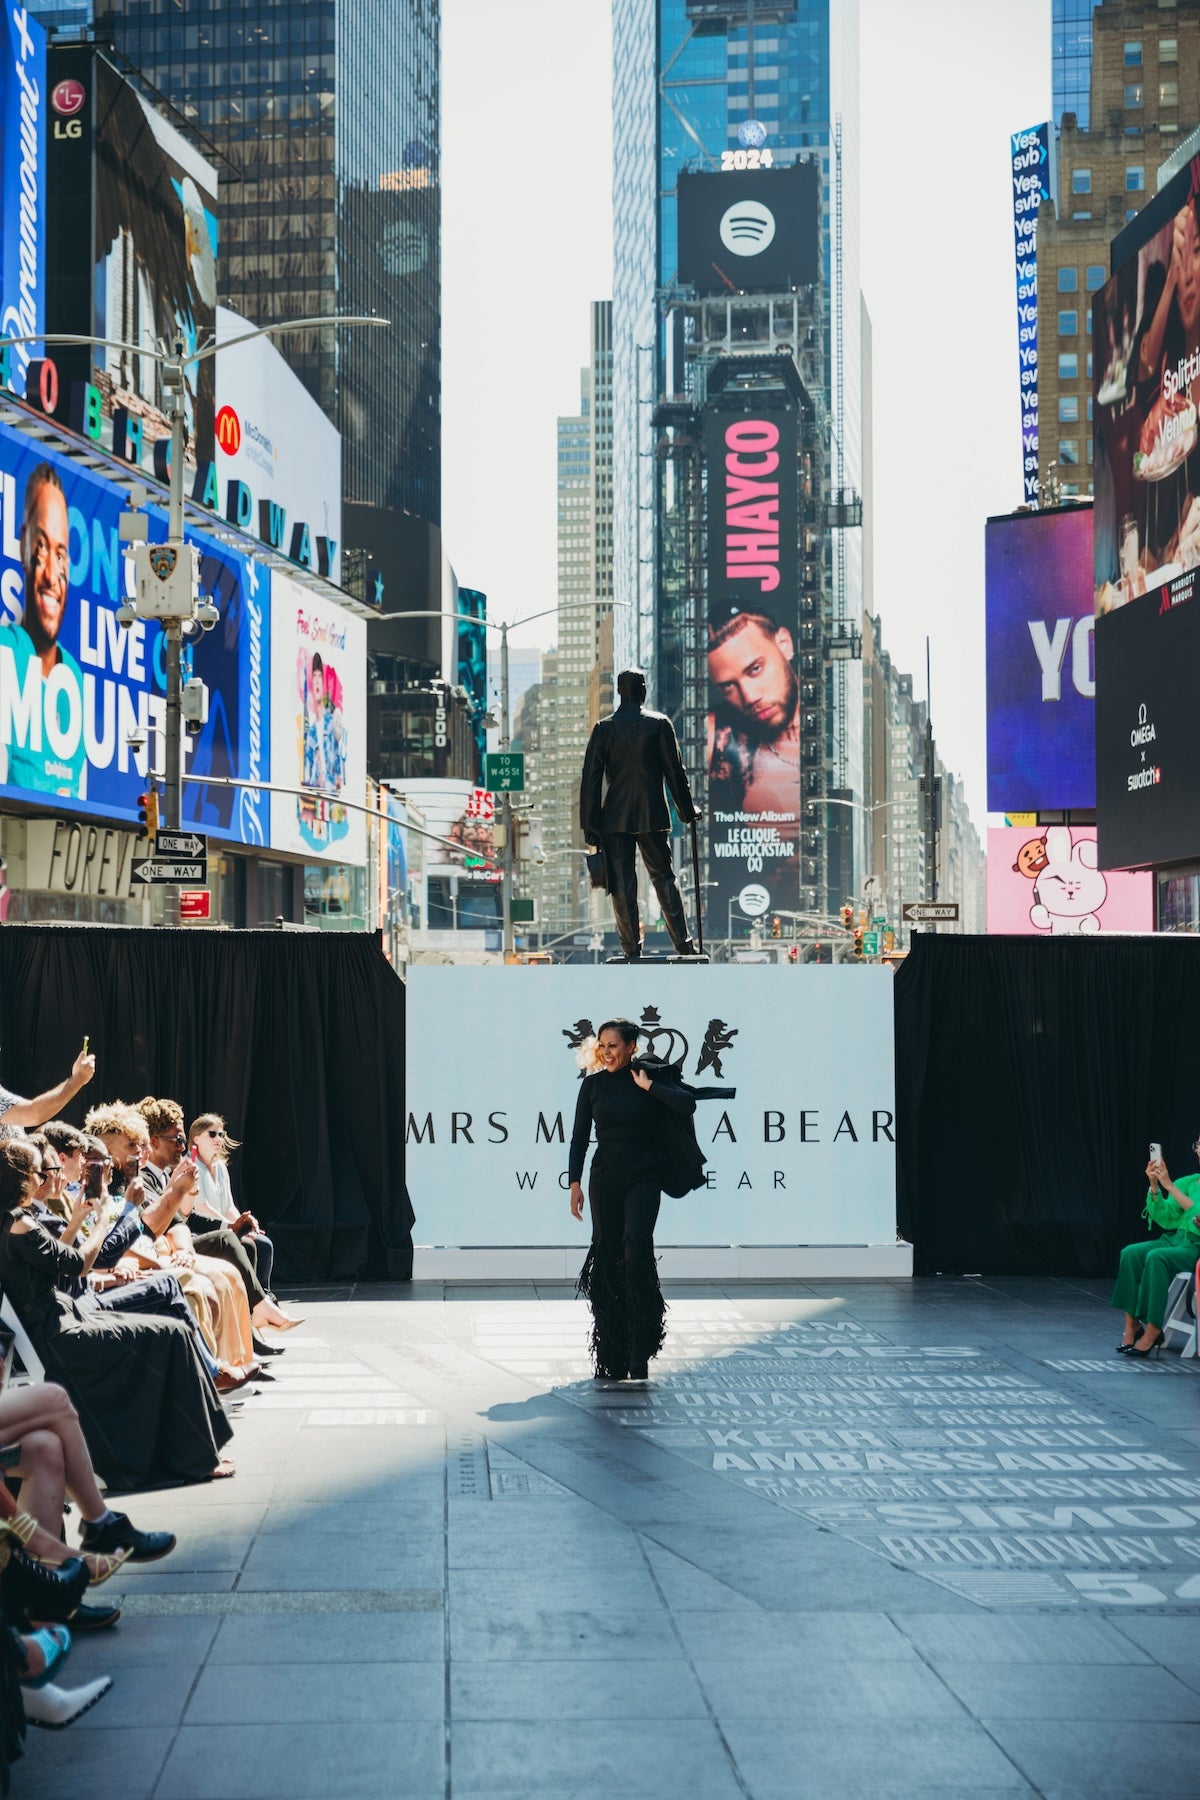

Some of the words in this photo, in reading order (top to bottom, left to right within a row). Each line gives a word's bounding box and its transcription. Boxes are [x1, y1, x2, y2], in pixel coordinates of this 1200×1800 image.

[54, 119, 82, 139] LG
[1012, 131, 1040, 151] Yes,
[721, 148, 773, 171] 2024
[1013, 147, 1040, 171] svb
[1013, 174, 1042, 195] Yes,
[1015, 191, 1041, 214] svb
[724, 419, 781, 592] JHAYCO
[68, 506, 119, 601] ON
[1171, 572, 1195, 593] MARRIOTT
[1171, 587, 1193, 605] MARQUIS
[80, 599, 146, 682] LIVE
[435, 694, 447, 748] 1500
[1130, 723, 1156, 747] OMEGA
[500, 757, 511, 766] TO
[491, 768, 498, 776] W
[499, 768, 511, 776] 45
[512, 768, 520, 776] St
[1127, 766, 1156, 792] swatch
[714, 811, 735, 822] The
[735, 811, 760, 822] New
[760, 811, 795, 822] Album
[162, 838, 178, 849] ONE
[184, 840, 199, 851] WAY
[728, 828, 740, 843] LE
[740, 828, 780, 844] CLIQUE:
[714, 843, 741, 857] VIDA
[741, 842, 795, 857] ROCKSTAR
[142, 866, 163, 877] ONE
[173, 867, 197, 876] WAY
[747, 857, 763, 873] (X)
[405, 1111, 508, 1144] MRS
[763, 1110, 896, 1143] BEAR
[829, 1375, 1041, 1388] IMPERIAL
[648, 1392, 898, 1406] FONTANNE
[705, 1429, 889, 1447] KERR
[944, 1429, 1144, 1447] O'NEILL
[712, 1451, 1188, 1472] AMBASSADOR
[744, 1477, 920, 1488] CIRCLE
[877, 1536, 1173, 1563] BROADWAY
